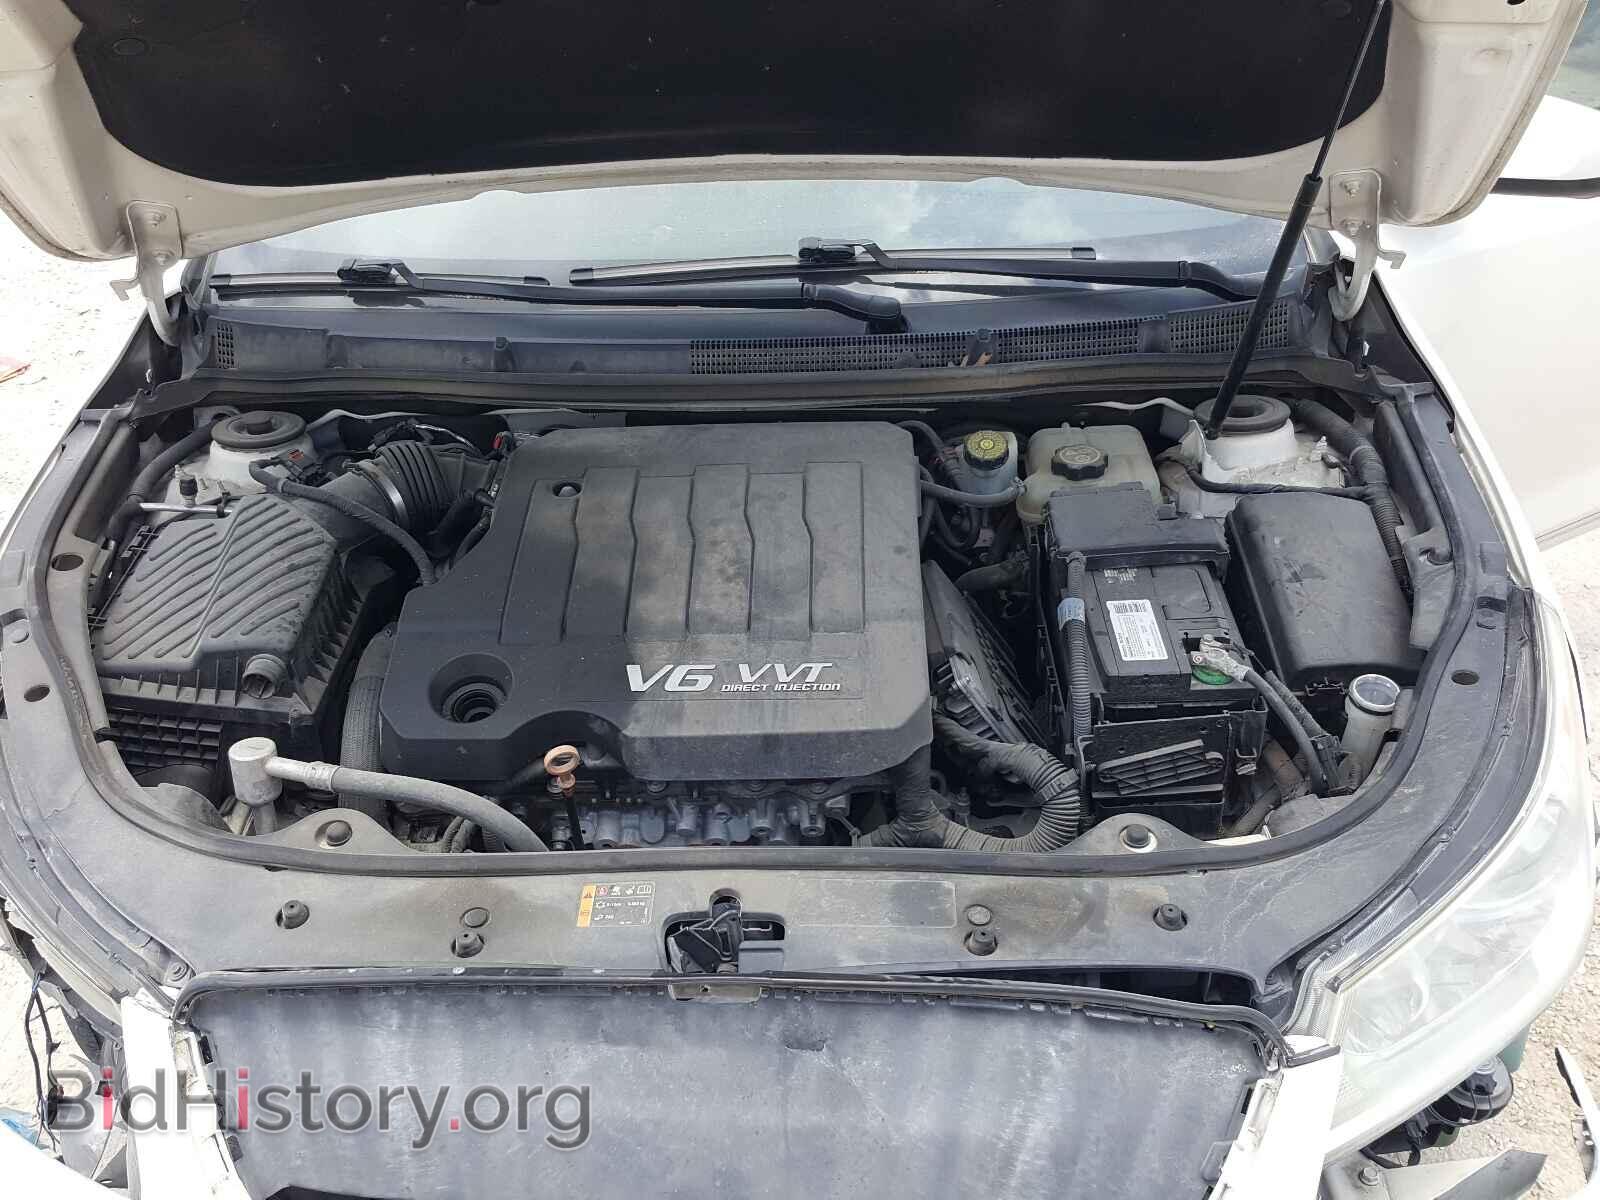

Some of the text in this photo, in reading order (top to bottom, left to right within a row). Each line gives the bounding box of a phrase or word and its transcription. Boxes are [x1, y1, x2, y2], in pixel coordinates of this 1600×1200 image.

[626, 663, 833, 692] V6 VVT
[720, 683, 841, 692] DIRECT INJECTION
